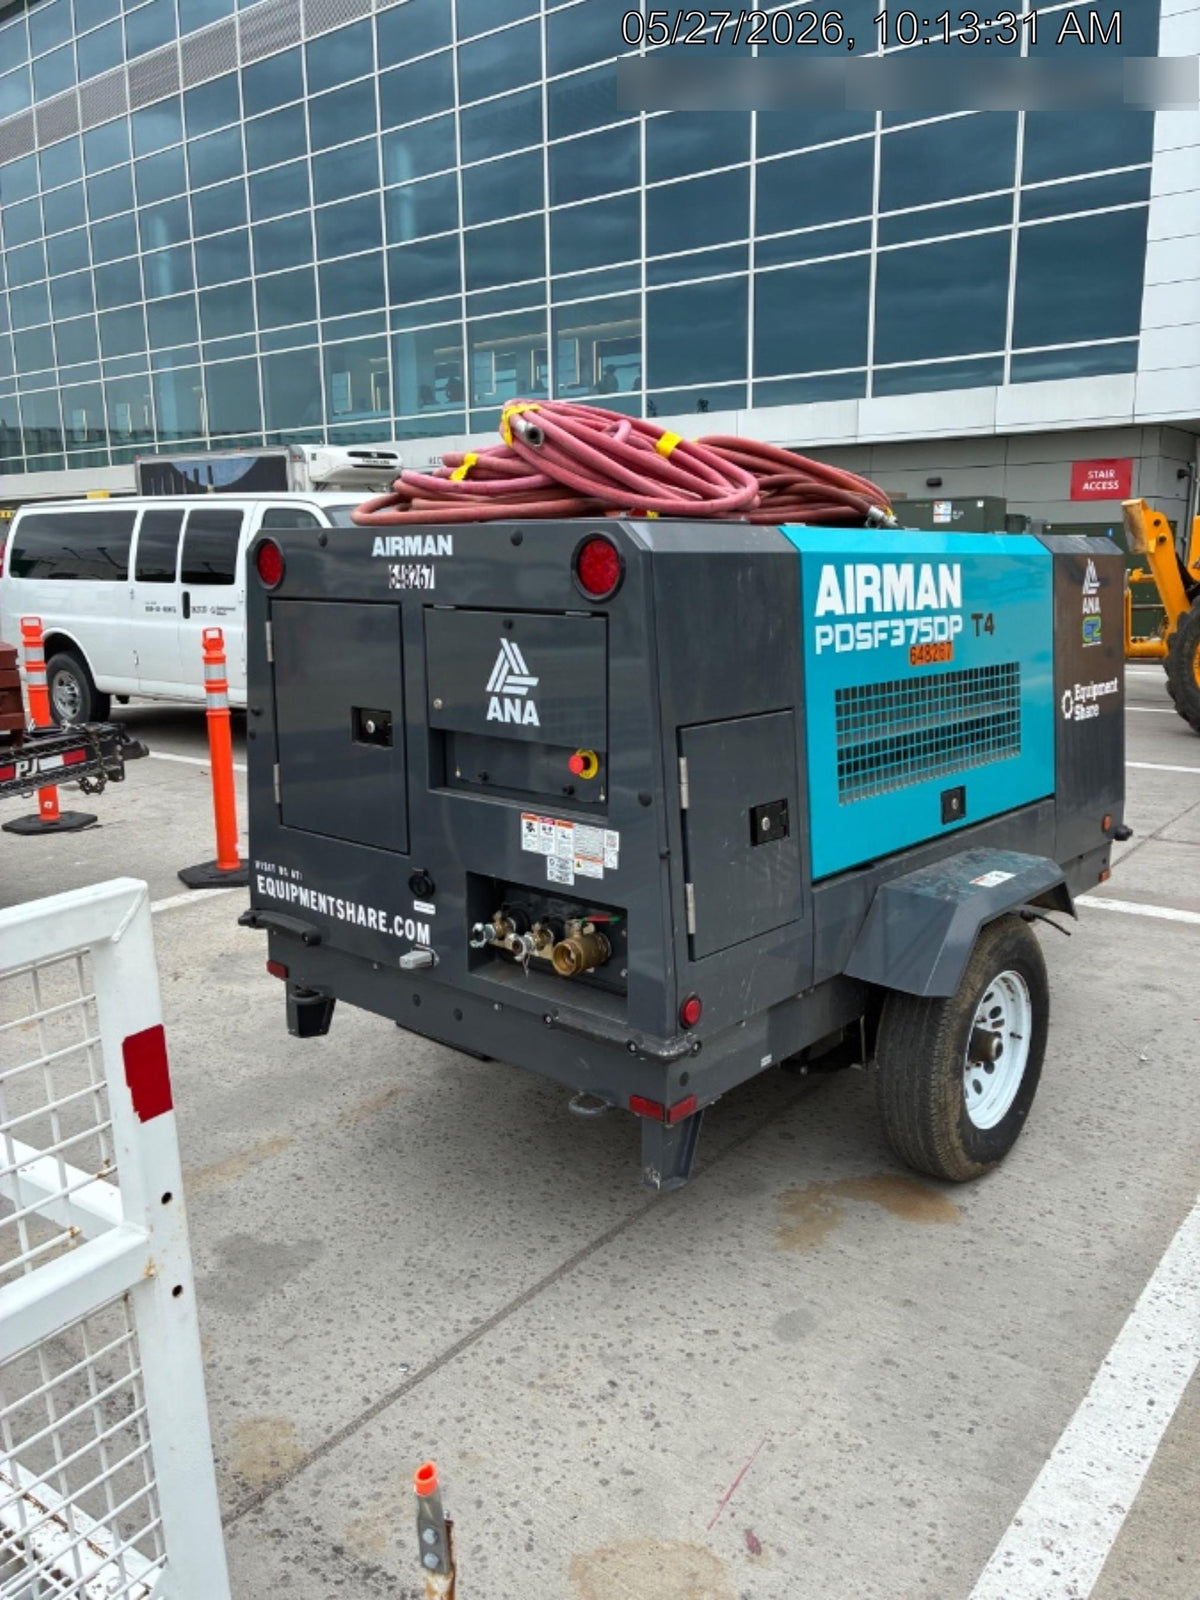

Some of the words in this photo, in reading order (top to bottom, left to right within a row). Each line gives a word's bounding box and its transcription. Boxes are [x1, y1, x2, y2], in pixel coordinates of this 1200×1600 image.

[1082, 480, 1120, 491] ACCESS
[1087, 469, 1116, 479] STAIR
[371, 534, 453, 557] AIRMAN
[814, 563, 963, 617] AIRMAN
[1082, 597, 1102, 615] ANA
[814, 614, 964, 655] PDSF375DP
[971, 612, 996, 637] T4
[1073, 677, 1119, 703] Equipment
[486, 696, 541, 726] ANA
[1073, 703, 1100, 721] Share
[256, 874, 431, 946] EQUIPMENTSHARE.COM
